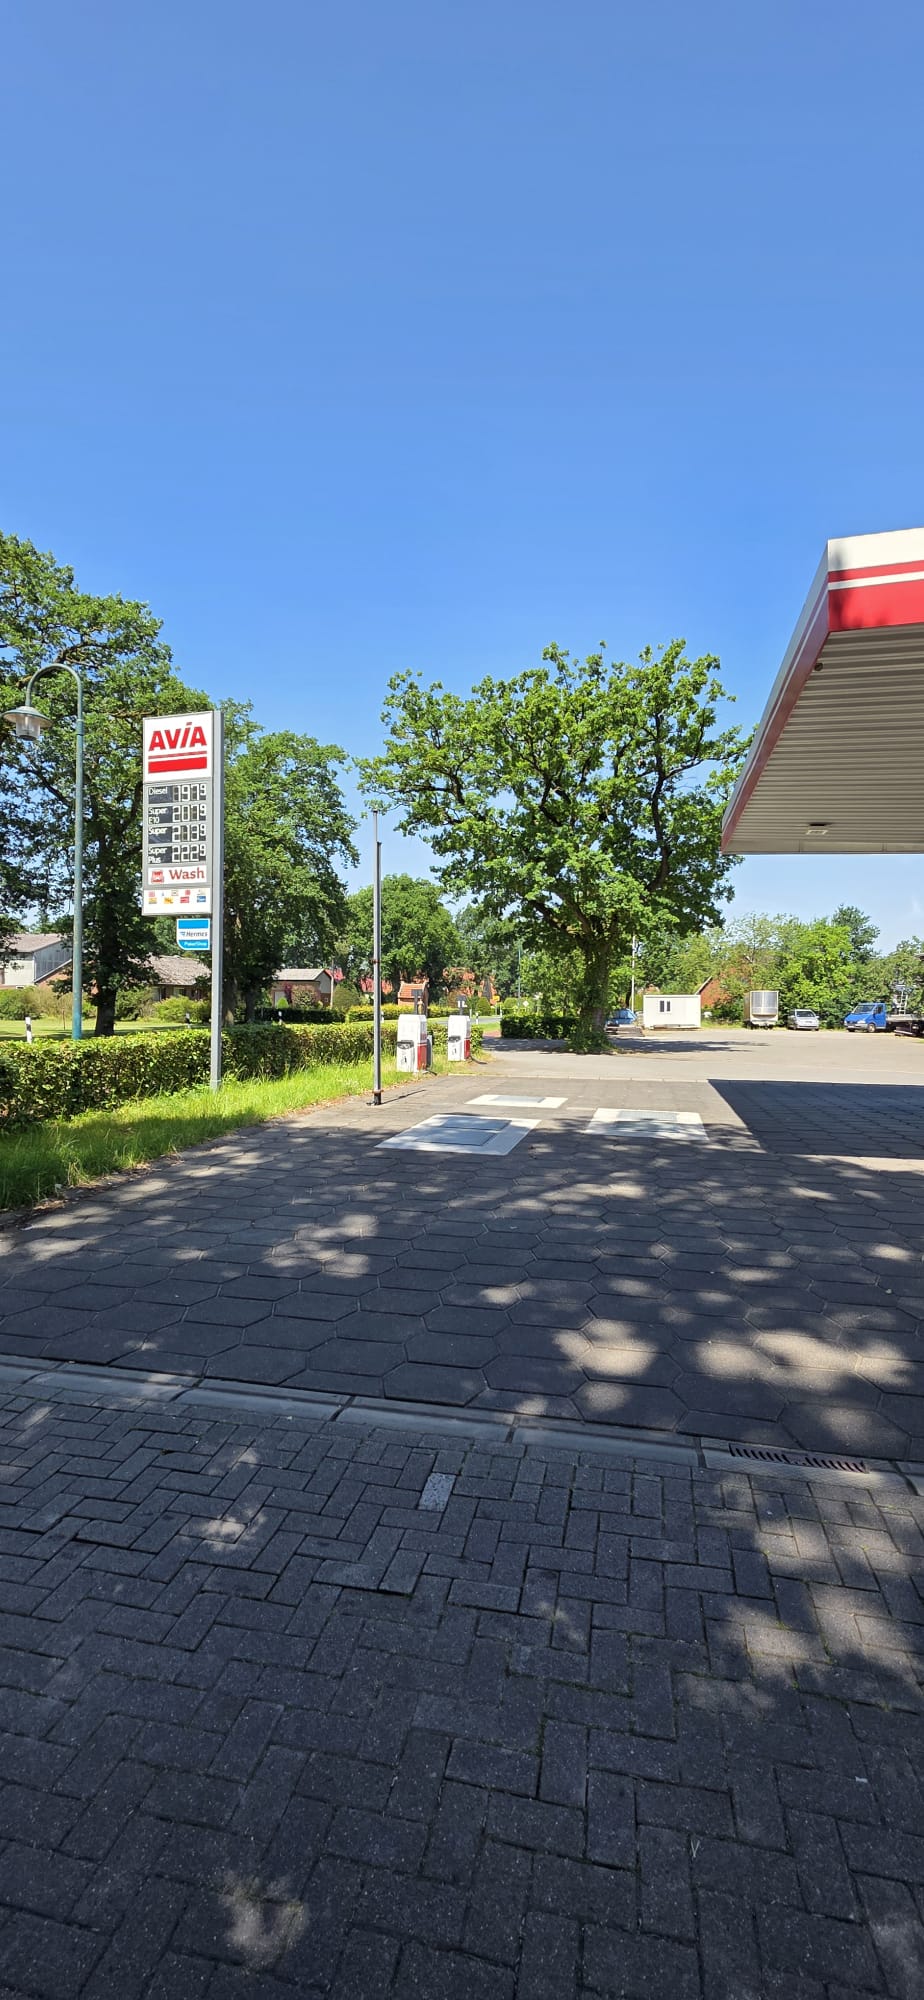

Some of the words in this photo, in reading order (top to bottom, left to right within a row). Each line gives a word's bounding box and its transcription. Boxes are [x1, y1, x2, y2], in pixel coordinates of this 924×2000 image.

[148, 786, 168, 796] Diesel
[148, 807, 168, 817] Super
[148, 826, 168, 836] Super
[148, 846, 168, 856] Super
[148, 855, 161, 864] Plus
[169, 867, 205, 880] Wash
